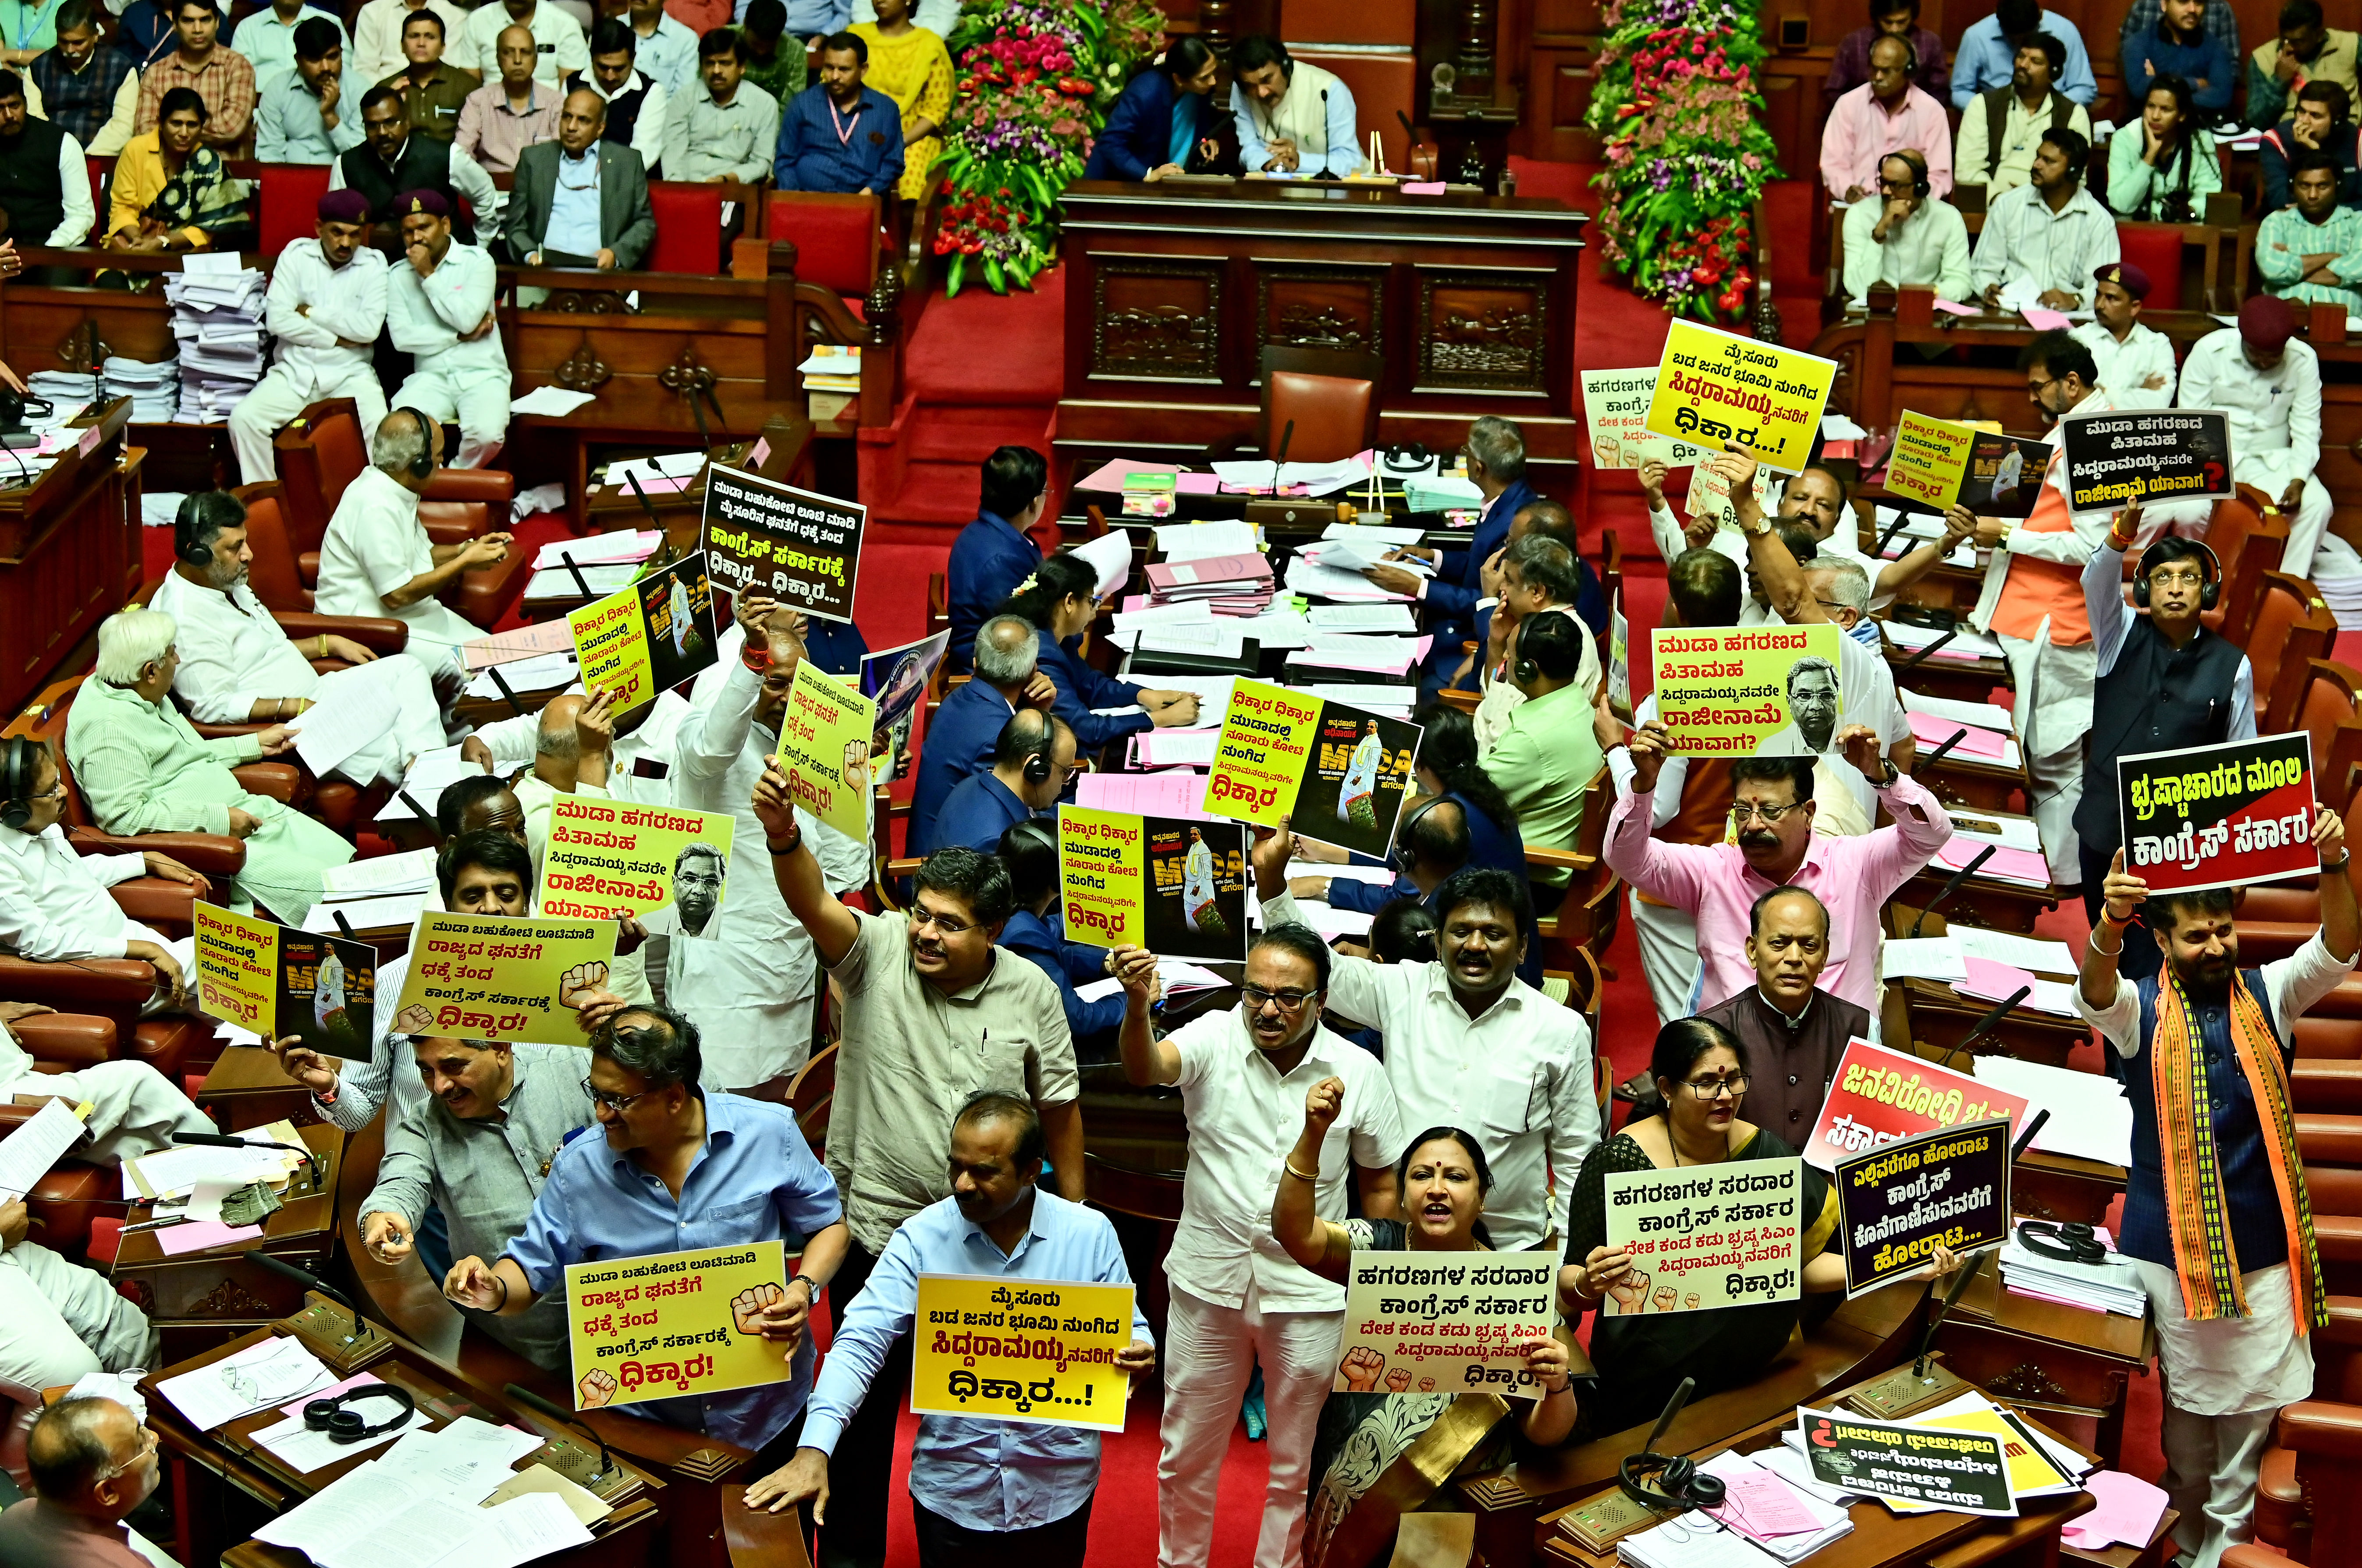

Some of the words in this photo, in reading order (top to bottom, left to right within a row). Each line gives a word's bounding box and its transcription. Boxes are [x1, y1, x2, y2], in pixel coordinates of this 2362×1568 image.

[1724, 344, 1779, 369] ಮೈಸೂರು
[1672, 352, 1697, 369] ಬಡ
[1699, 360, 1730, 378] ಜನರ
[1734, 369, 1772, 390] ಭೂಮಿ
[1774, 379, 1818, 401] ನುಂಗಿದ
[1668, 370, 1809, 425] ಸಿದ್ದರಾಮಯ್ಯನವರಿಗೆ
[1598, 417, 1618, 427] ದೇಶ
[2086, 420, 2133, 435] ಮುಡಾ
[2138, 417, 2202, 431] ಹಗರಣದ
[1902, 433, 1951, 457] ಮುಡಾದಲ್ಲಿ
[2111, 433, 2177, 450] ಪಿತಾಮಹ
[1897, 452, 1932, 470] ನುಂಗಿದ
[2073, 454, 2192, 480] ಸಿದ್ದರಾಮಯ್ಯನವರೇ
[1892, 469, 1943, 499] ಧಿಕ್ಕಾರ
[2075, 476, 2146, 504] ರಾಜೀನಾಮೆ
[714, 481, 742, 499] ಮುಡಾ
[744, 490, 795, 514] ಬಹುಕೋಟಿ
[797, 506, 824, 522] ಲೂಟಿ
[826, 513, 856, 530] ಮಾಡಿ
[720, 500, 764, 523] ಮೈಸೂರಿನ
[766, 515, 799, 533] ಘನತೆಗೆ
[800, 525, 819, 543] ಧಕ್ಕೆ
[820, 529, 844, 544] ತಂದ
[710, 526, 771, 558] ಕಾಂಗ್ರೆಸ್
[773, 546, 845, 587] ಸರ್ಕಾರಕ್ಕೆ
[772, 571, 840, 606] ಧಿಕ್ಕಾರ...
[574, 613, 605, 637] ಧಿಕ್ಕಾರ
[607, 598, 636, 622] ಧಿಕ್ಕಾರ
[580, 623, 630, 652] ಮುಡಾದಲ್ಲಿ
[584, 643, 618, 665] ನೂರಾರು
[620, 630, 642, 648] ಕೋಟಿ
[1658, 636, 1718, 653] ಮುಡಾ
[1724, 631, 1807, 652] ಹಗರಣದ
[587, 655, 622, 679] ನುಂಗಿದ
[1659, 660, 1744, 680] ಪಿತಾಮಹ
[794, 690, 814, 717] ರಾಜ್ಯದ
[815, 701, 838, 726] ಘನತೆಗೆ
[799, 670, 812, 685] ಮುಡಾ
[813, 677, 836, 701] ಬಹುಕೋಟಿ
[837, 693, 864, 717] ಲೂಟಿಮಾಡಿ
[1233, 691, 1271, 715] ಧಿಕ್ಕಾರ
[1274, 701, 1315, 725] ಧಿಕ್ಕಾರ
[1661, 684, 1779, 705] ಸಿದ್ದರಾಮಯ್ಯನವರೇ
[787, 715, 799, 740] ಧಕ್ಕೆ
[799, 721, 815, 742] ತಂದ
[1230, 713, 1291, 742] ಮುಡಾದಲ್ಲಿ
[1663, 702, 1782, 726] ರಾಜೀನಾಮೆ
[1222, 745, 1266, 764] ನುಂಗಿದ
[1226, 729, 1269, 747] ನೂರಾರು
[1272, 740, 1304, 756] ಕೋಟಿ
[784, 744, 809, 771] ಕಾಂಗ್ರೆಸ್
[810, 757, 841, 790] ಸರ್ಕಾರಕ್ಕೆ
[789, 766, 832, 816] ಧಿಕ್ಕಾರ!
[1211, 773, 1278, 814] ಧಿಕ್ಕಾರ
[1381, 780, 1405, 790] ಹಗರಣ
[2131, 760, 2242, 820] ಭ್ರಷ್ಟಾಚಾರದ
[2246, 756, 2302, 792] ಮೂಲ
[556, 801, 615, 822] ಮುಡಾ
[621, 809, 703, 834] ಹಗರಣದ
[1062, 818, 1097, 841] ಧಿಕ್ಕಾರ
[1101, 824, 1137, 846] ಧಿಕ್ಕಾರ
[553, 826, 636, 850] ಪಿತಾಮಹ
[2133, 818, 2228, 870] ಕಾಂಗ್ರೆಸ್
[2234, 806, 2309, 854] ಸರ್ಕಾರ
[550, 851, 667, 875] ಸಿದ್ದರಾಮಯ್ಯನವರೇ
[1065, 841, 1122, 865] ಮುಡಾದಲ್ಲಿ
[1066, 857, 1105, 873] ನೂರಾರು
[1108, 864, 1138, 877] ಕೋಟಿ
[547, 873, 664, 901] ರಾಜೀನಾಮೆ
[1067, 873, 1105, 890] ನುಂಗಿದ
[1221, 884, 1243, 892] ಹಗರಣ
[198, 913, 232, 937] ಧಿಕ್ಕಾರ
[236, 926, 273, 950] ಧಿಕ್ಕಾರ
[432, 921, 469, 933] ಮುಡಾ
[472, 925, 533, 938] ಬಹುಕೋಟಿ
[536, 928, 595, 940] ಲೂಟಿಮಾಡಿ
[1068, 902, 1126, 940] ಧಿಕ್ಕಾರ
[200, 933, 256, 964] ಮುಡಾದಲ್ಲಿ
[201, 947, 239, 967] ನೂರಾರು
[242, 960, 271, 978] ಕೋಟಿ
[427, 939, 484, 961] ರಾಜ್ಯದ
[487, 944, 543, 961] ಘನತೆಗೆ
[201, 959, 239, 981] ನುಂಗಿದ
[421, 961, 451, 983] ಧಕ್ಕೆ
[454, 965, 494, 981] ತಂದ
[202, 983, 258, 1023] ಧಿಕ್ಕಾರ
[425, 987, 486, 1003] ಕಾಂಗ್ರೆಸ್
[487, 993, 551, 1013] ಸರ್ಕಾರಕ್ಕೆ
[436, 1005, 528, 1038] ಧಿಕ್ಕಾರ!
[1854, 1152, 1920, 1188] ಎಲ್ಲಿವರೆಗೂ
[1923, 1135, 1989, 1164] ಹೋರಾಟ
[1613, 1177, 1713, 1206] ಹಗರಣಗಳ
[1719, 1169, 1794, 1196] ಸರದಾರ
[1887, 1167, 1951, 1206] ಕಾಂಗ್ರೆಸ್
[1638, 1205, 1720, 1234] ಕಾಂಗ್ರೆಸ್
[1725, 1197, 1794, 1223] ಸರ್ಕಾರ
[1854, 1185, 1992, 1249] ಕೊನೆಗಾಣಿಸುವವರೆಗೆ
[1624, 1239, 1655, 1256] ದೇಶ
[1659, 1235, 1691, 1252] ಕಂಡ
[1695, 1232, 1723, 1247] ಕಡು
[1728, 1227, 1759, 1250] ಭ್ರಷ್ಟ
[1760, 1225, 1795, 1241] ಸಿಎಂ
[579, 1271, 618, 1285] ಮುಡಾ
[622, 1260, 686, 1279] ಬಹುಕೋಟಿ
[690, 1251, 756, 1270] ಲೂಟಿಮಾಡಿ
[1658, 1243, 1792, 1277] ಸಿದ್ದರಾಮಯ್ಯನವರಿಗೆ
[1357, 1266, 1465, 1285] ಹಗರಣಗಳ
[1470, 1265, 1550, 1285] ಸರದಾರ
[1726, 1268, 1795, 1300] ಧಿಕ್ಕಾರ!
[582, 1284, 639, 1309] ರಾಜ್ಯದ
[645, 1275, 703, 1302] ಘನತೆಗೆ
[991, 1287, 1061, 1311] ಮೈಸೂರು
[1380, 1293, 1470, 1320] ಕಾಂಗ್ರೆಸ್
[1474, 1294, 1548, 1315] ಸರ್ಕಾರ
[583, 1313, 618, 1337] ಧಕ್ಕೆ
[619, 1309, 658, 1329] ತಂದ
[929, 1309, 959, 1324] ಬಡ
[963, 1311, 1005, 1327] ಜನರ
[1009, 1313, 1058, 1332] ಭೂಮಿ
[1062, 1317, 1119, 1334] ನುಂಗಿದ
[1360, 1320, 1395, 1335] ದೇಶ
[1399, 1322, 1435, 1336] ಕಂಡ
[1439, 1323, 1470, 1337] ಕಡು
[1474, 1322, 1510, 1344] ಭ್ರಷ್ಟ
[1511, 1323, 1547, 1337] ಸಿಎಂ
[596, 1336, 658, 1358] ಕಾಂಗ್ರೆಸ್
[663, 1327, 732, 1348] ಸರ್ಕಾರಕ್ಕೆ
[931, 1330, 1115, 1373] ಸಿದ್ದರಾಮಯ್ಯನವರಿಗೆ
[619, 1353, 714, 1393] ಧಿಕ್ಕಾರ!
[948, 1370, 1094, 1413] ಧಿಕ್ಕಾರ...!
